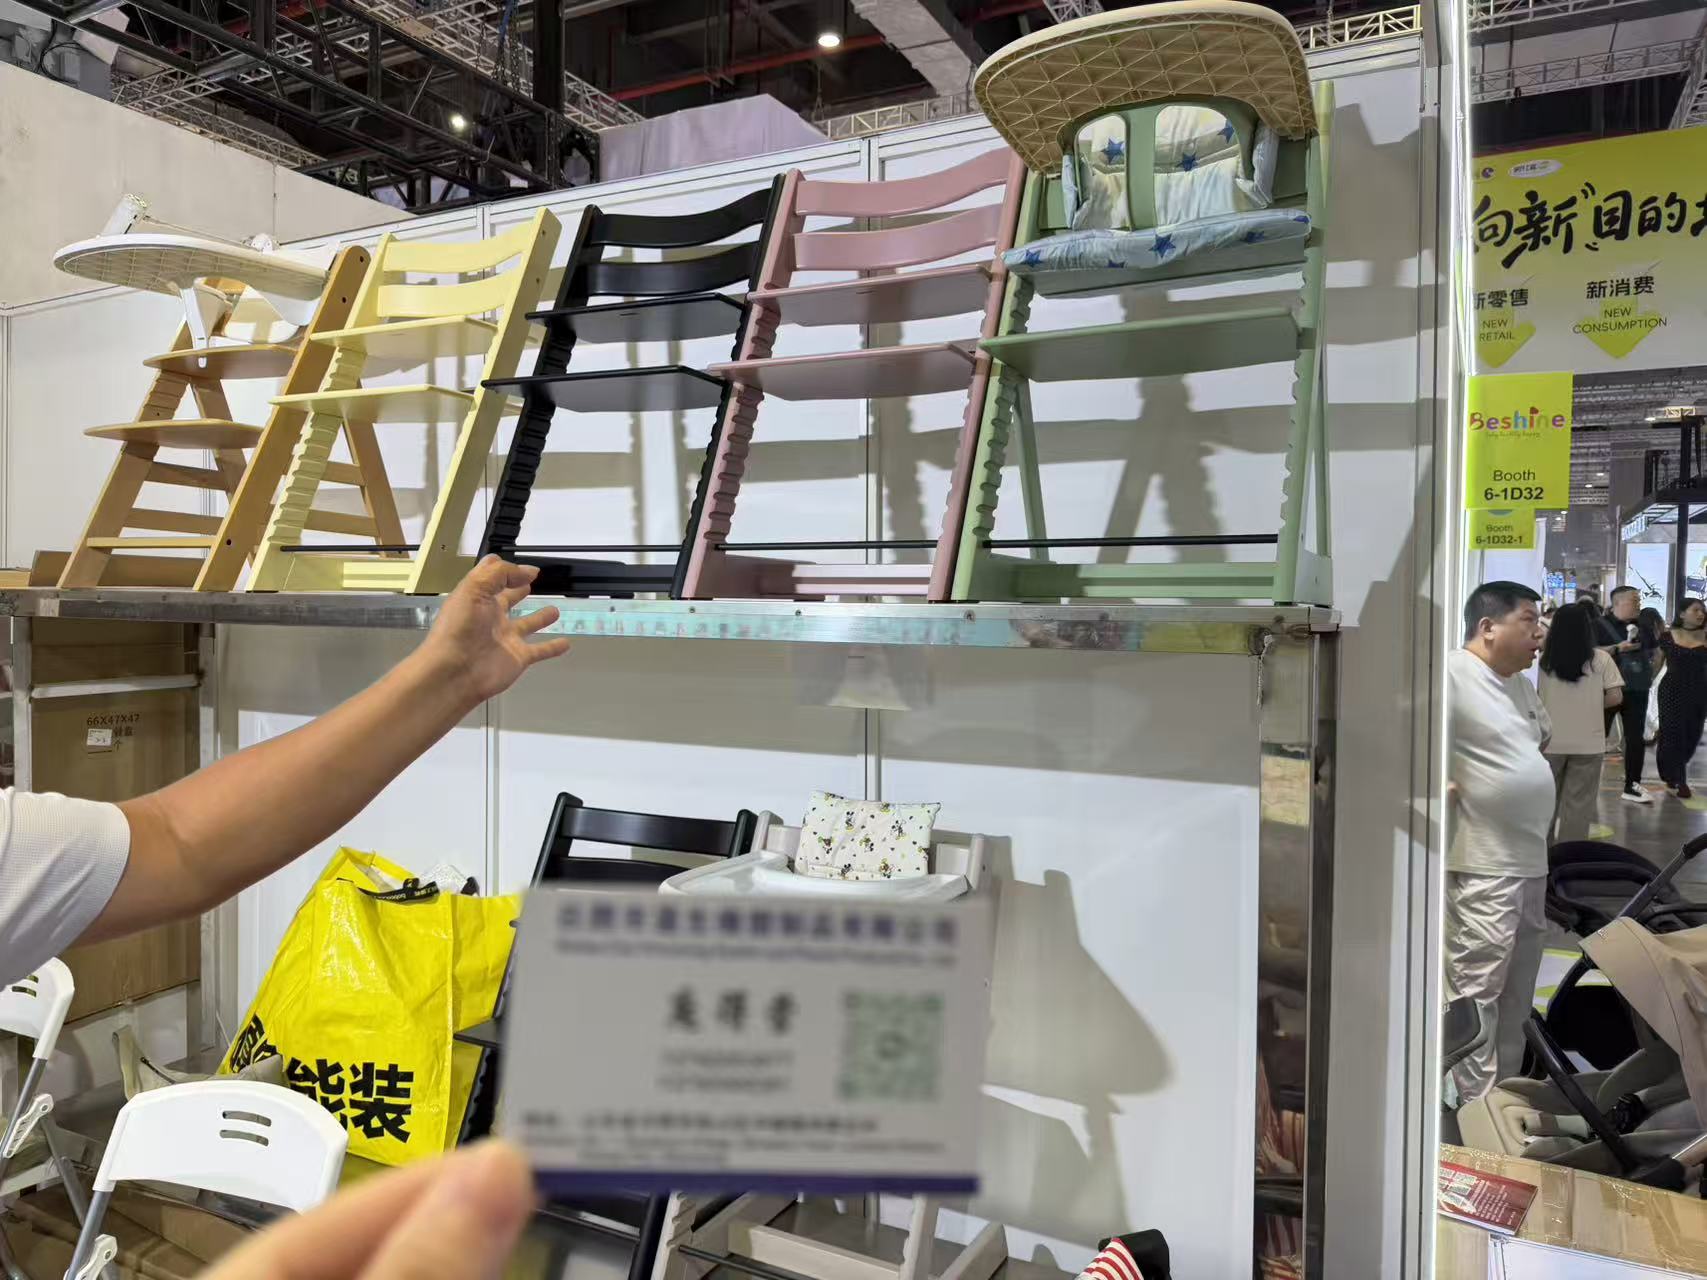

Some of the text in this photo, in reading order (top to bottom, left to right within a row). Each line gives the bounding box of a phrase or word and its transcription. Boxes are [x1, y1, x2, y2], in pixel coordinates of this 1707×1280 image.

[1586, 276, 1655, 299] 新消费
[1604, 307, 1632, 318] NEW
[1482, 319, 1509, 329] NEW
[1572, 317, 1667, 334] CONSUMPTION
[1479, 331, 1516, 342] RETAIL
[1469, 406, 1567, 430] Beshine
[1493, 469, 1536, 482] Booth
[1484, 486, 1545, 501] 6-1D32
[1486, 524, 1514, 533] Booth
[1475, 535, 1523, 545] 6-1D32-1
